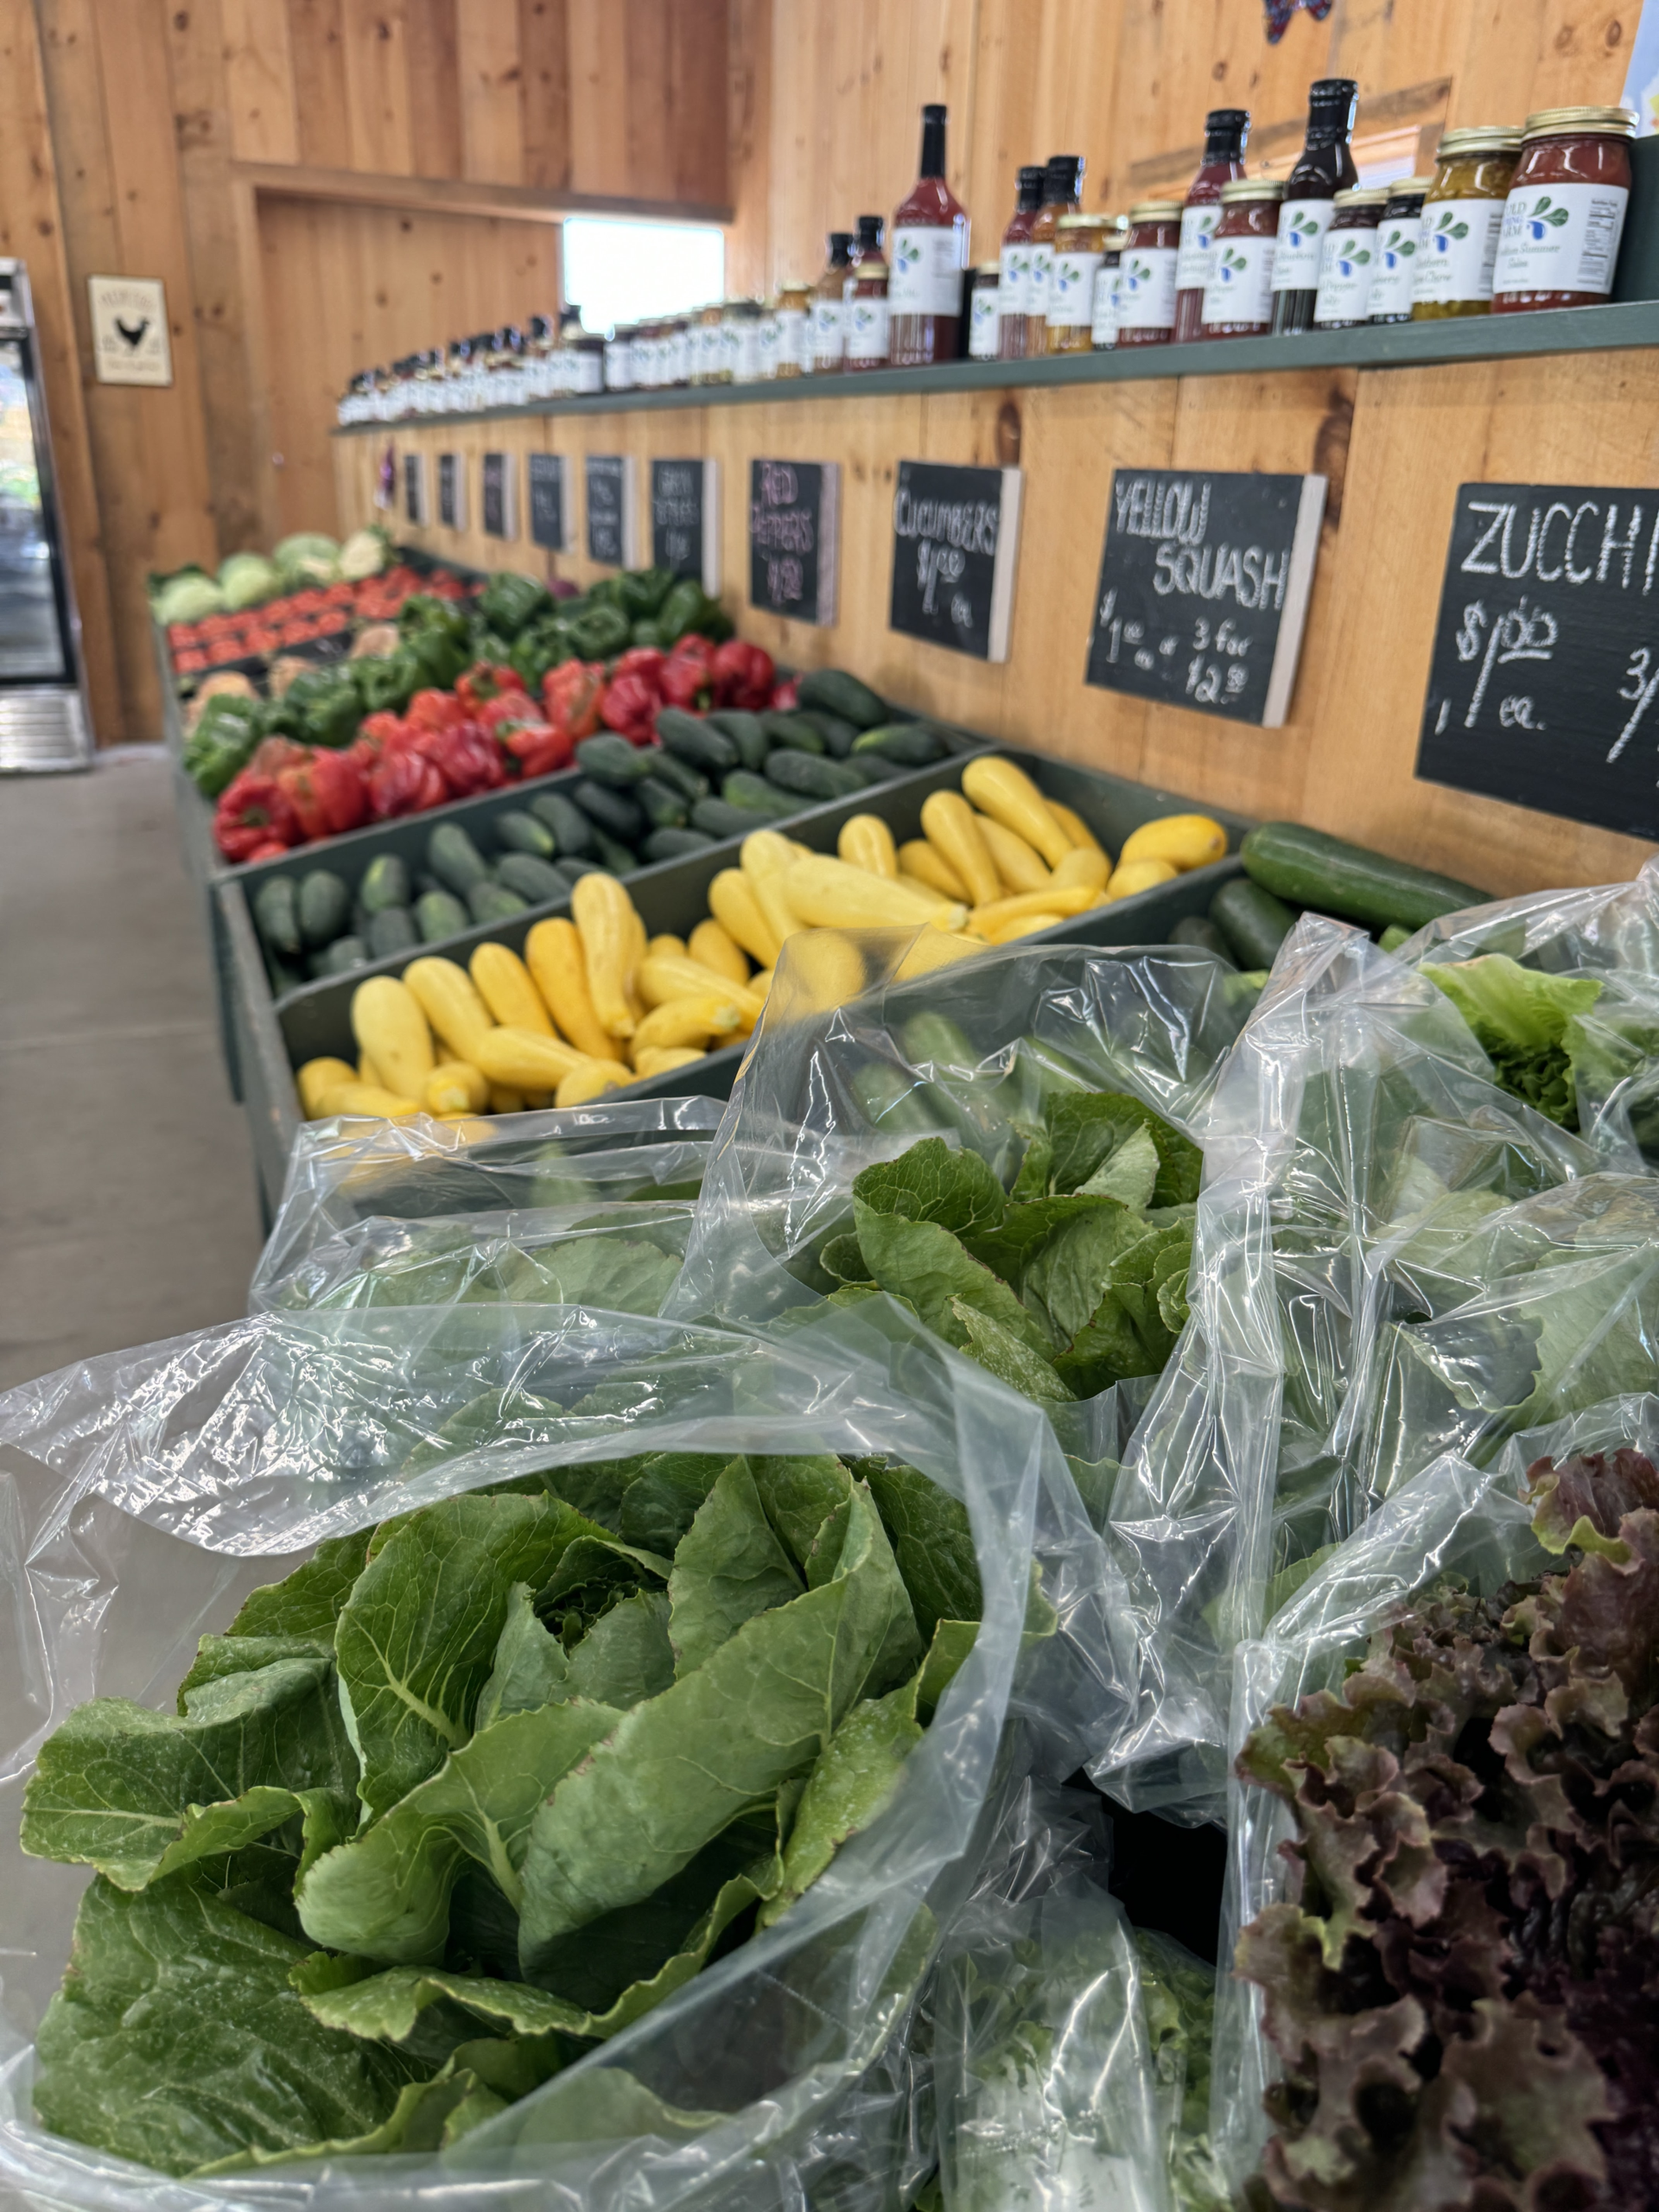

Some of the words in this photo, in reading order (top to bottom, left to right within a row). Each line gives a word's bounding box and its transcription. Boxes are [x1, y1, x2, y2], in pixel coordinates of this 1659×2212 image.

[1116, 479, 1211, 545] YELLOW
[1153, 542, 1290, 611] SQUASH
[1192, 616, 1211, 651] 3
